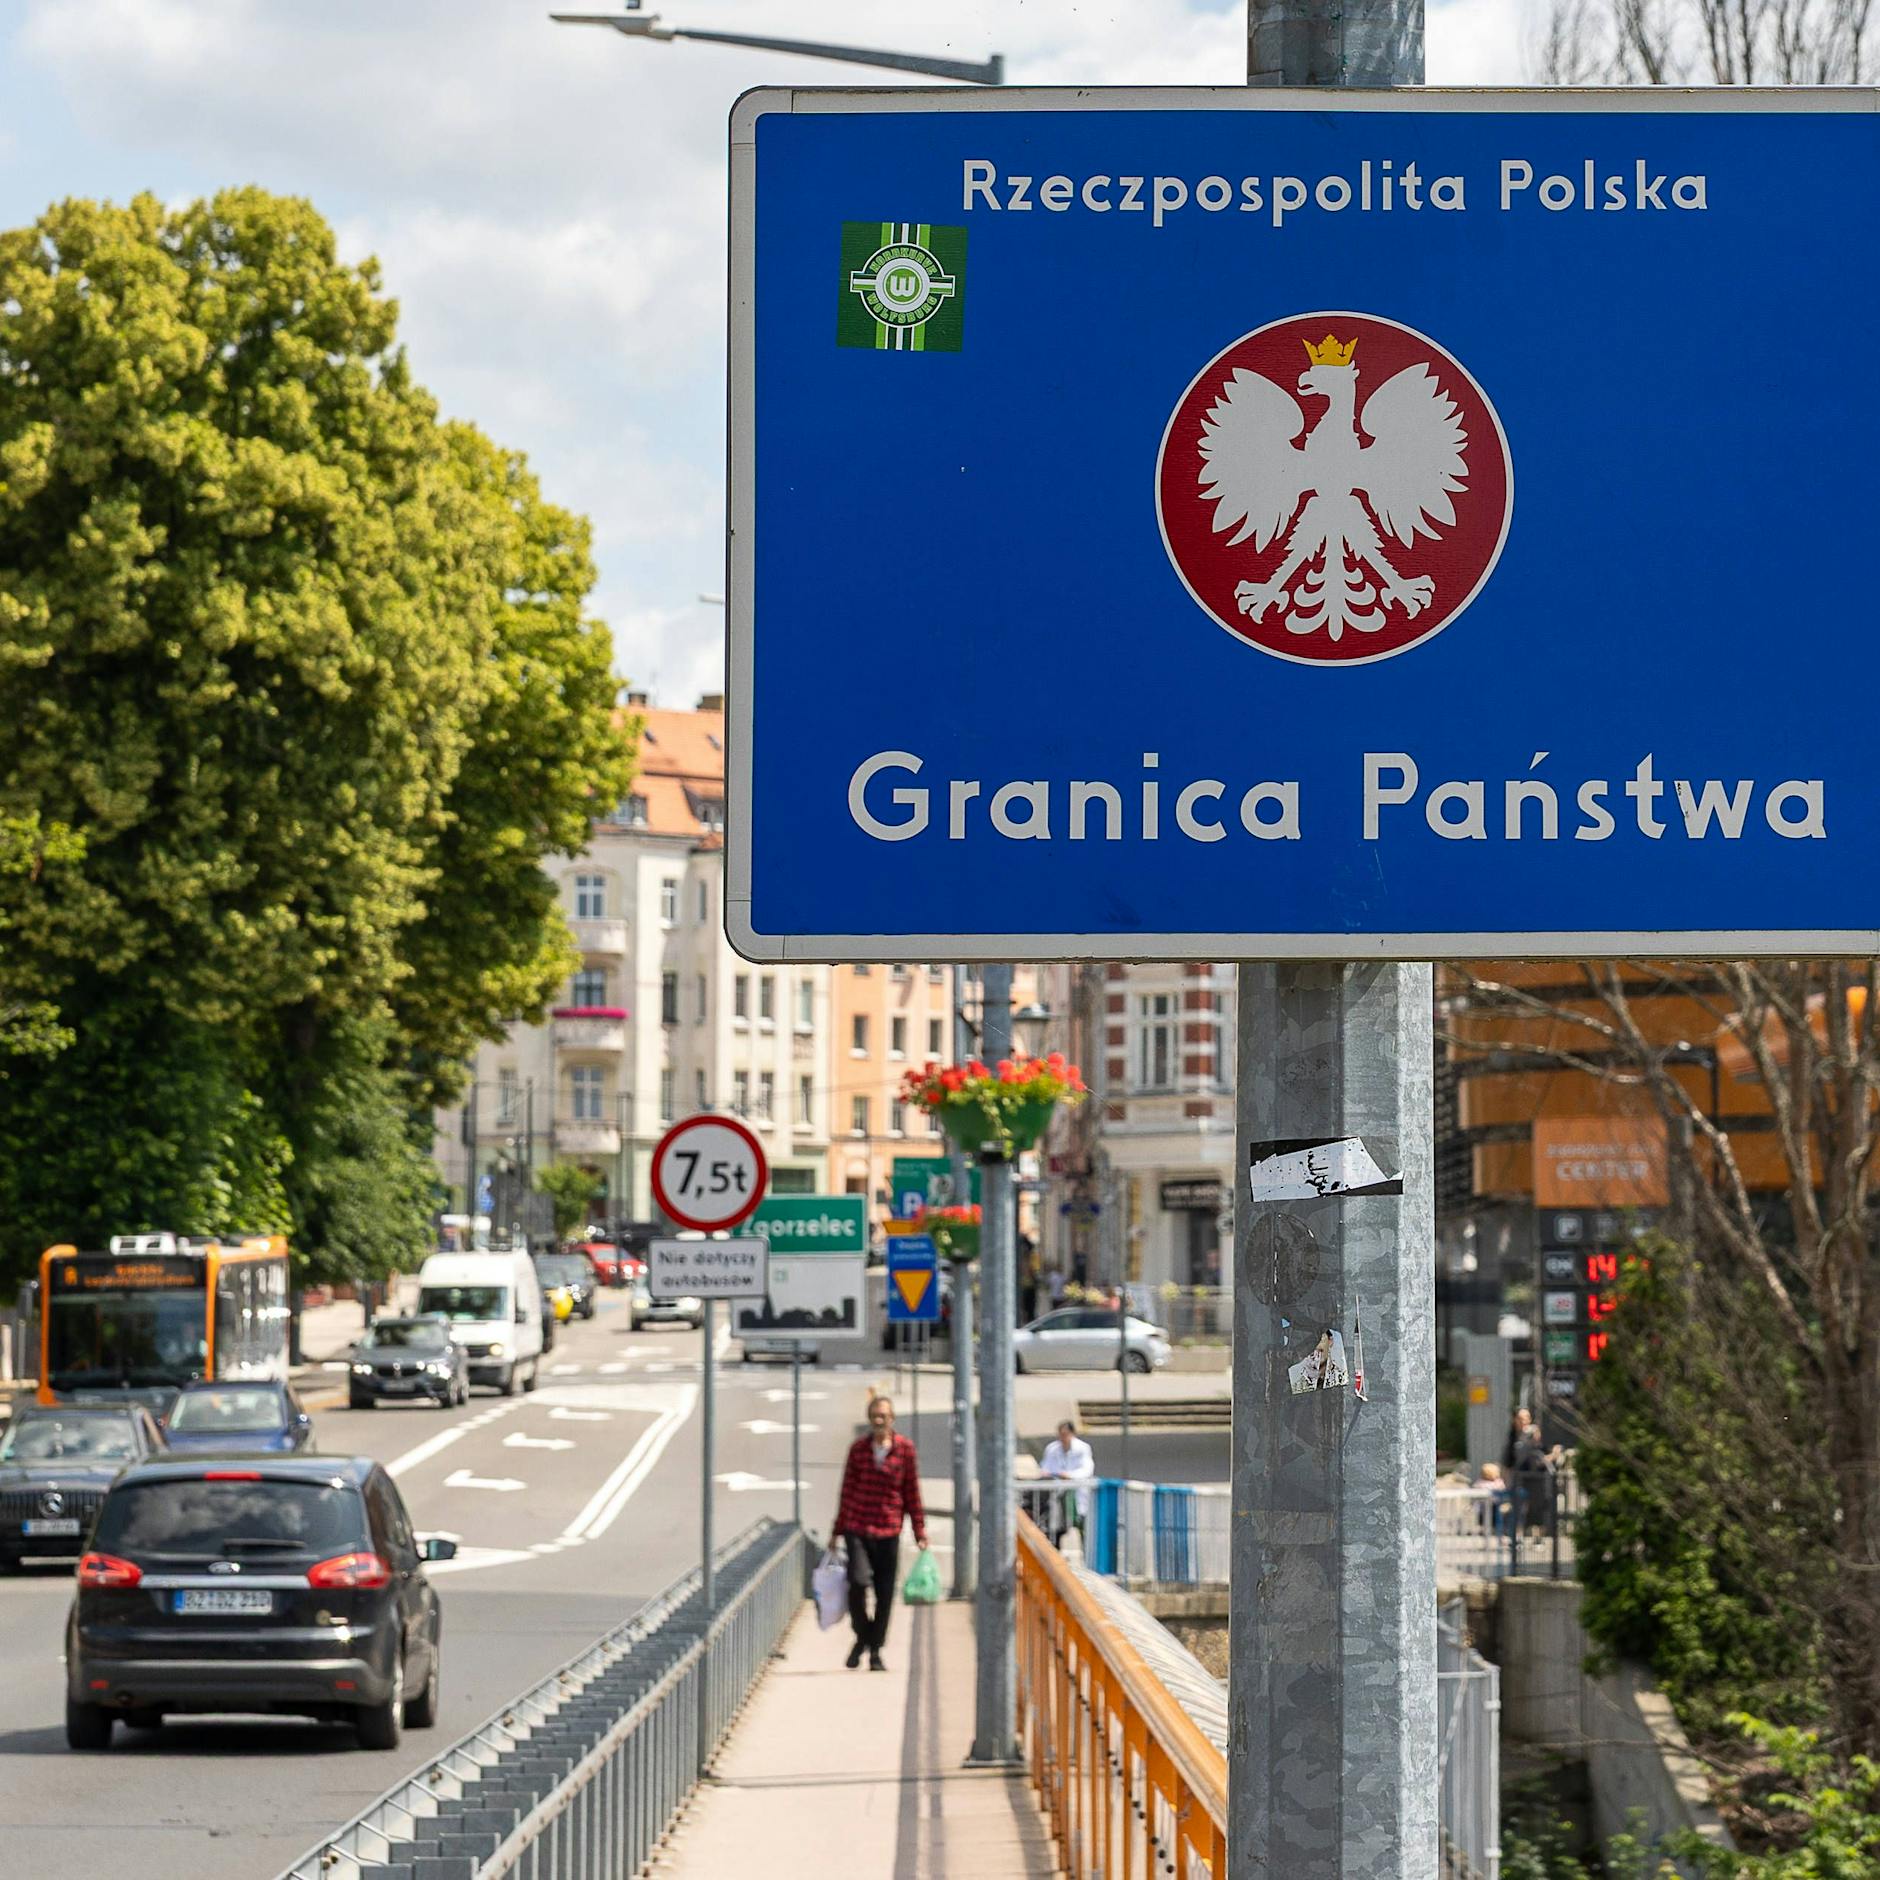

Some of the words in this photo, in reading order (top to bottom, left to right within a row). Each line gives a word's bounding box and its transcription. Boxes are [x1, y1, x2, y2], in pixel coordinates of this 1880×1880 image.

[963, 159, 1466, 227] Rzeczpospolita
[1501, 158, 1708, 212] Polska
[869, 247, 938, 277] NORDKURVE
[866, 291, 938, 324] WOLFSBURG
[847, 750, 1302, 843] Granica
[1363, 751, 1828, 842] Państwa
[674, 1150, 746, 1199] 7,5t
[659, 1250, 687, 1265] Nie
[694, 1249, 756, 1268] dotyczy
